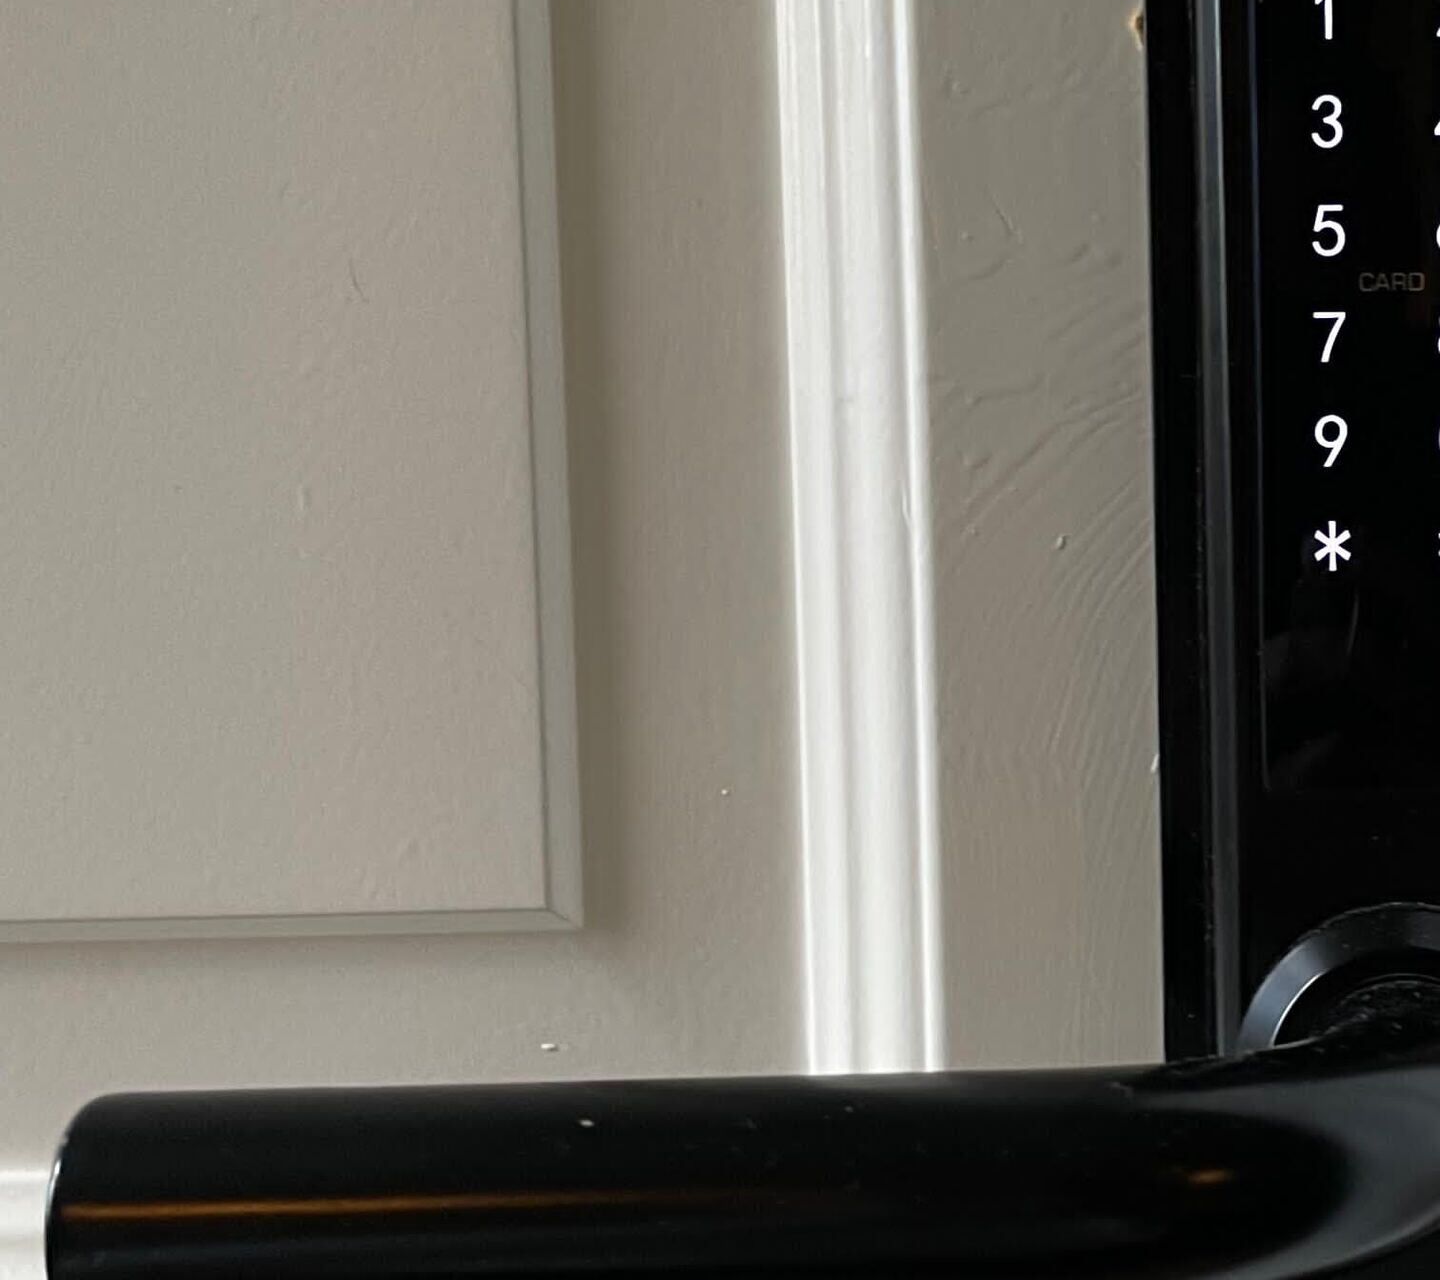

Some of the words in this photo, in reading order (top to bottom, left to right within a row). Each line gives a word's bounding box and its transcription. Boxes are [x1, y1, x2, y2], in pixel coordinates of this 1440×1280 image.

[1310, 93, 1345, 150] 3
[1310, 203, 1347, 258] 5
[1358, 271, 1426, 292] CARD
[1311, 310, 1347, 364] 7
[1313, 413, 1349, 469] 9
